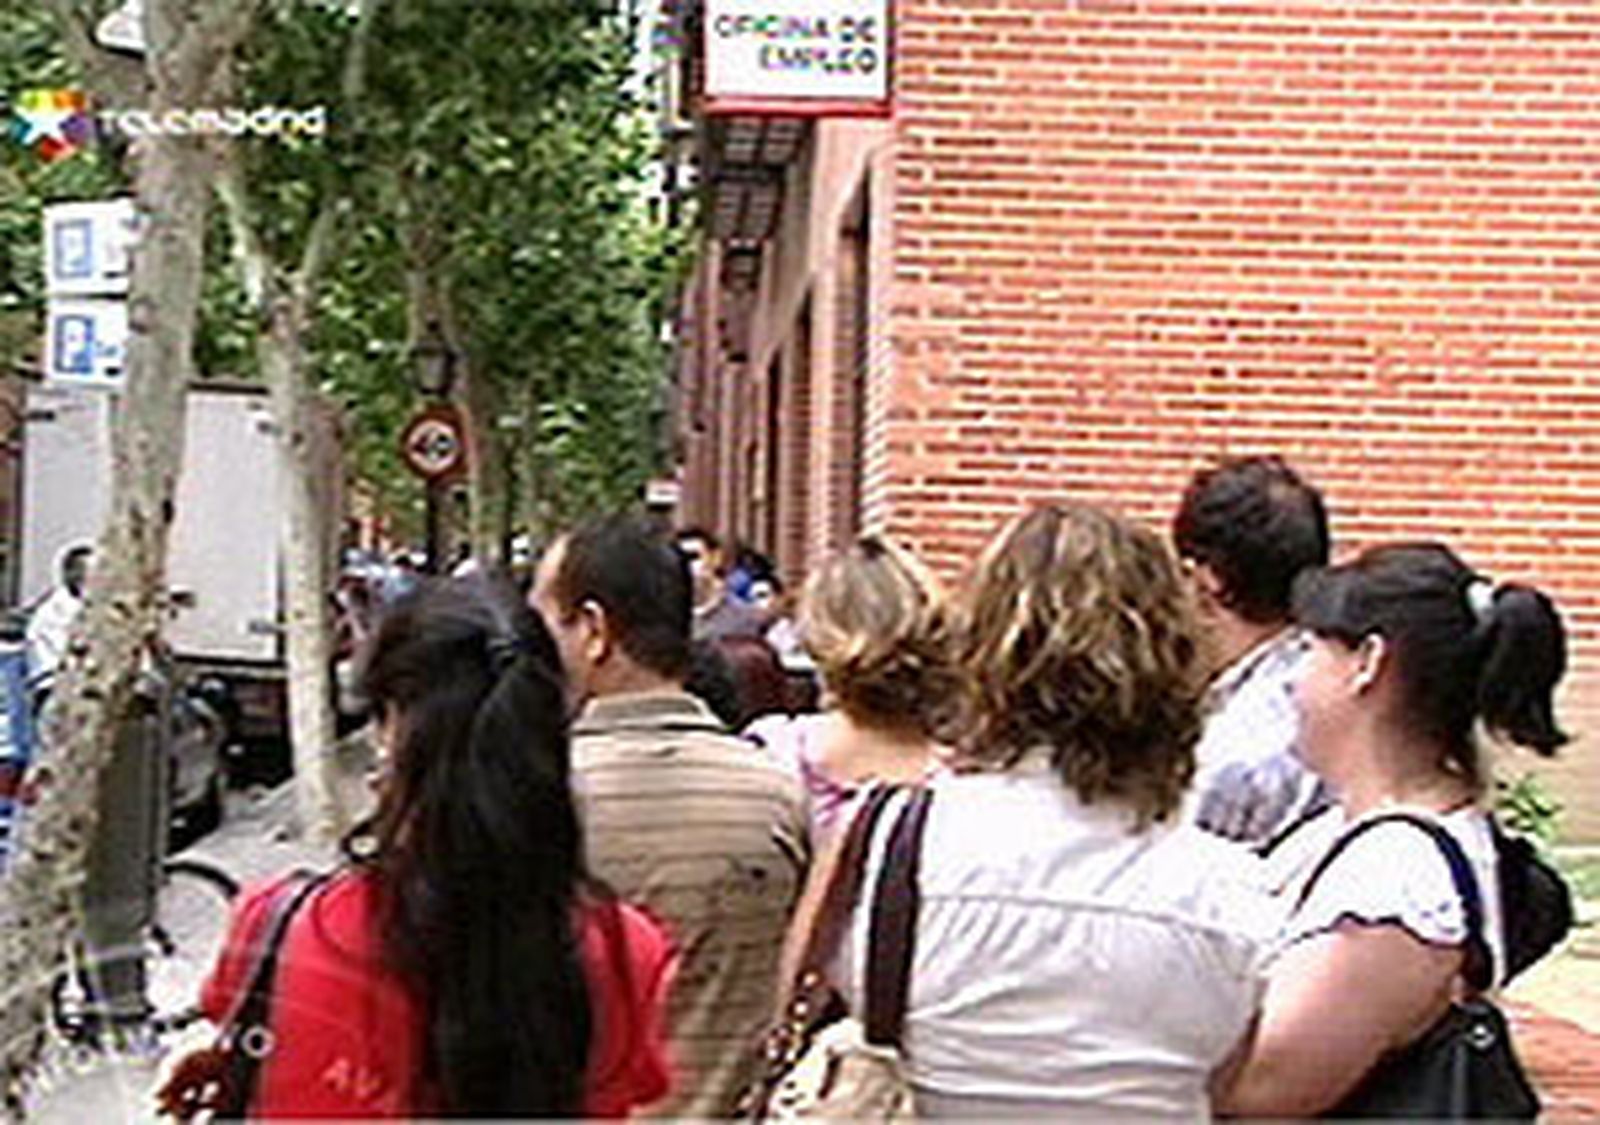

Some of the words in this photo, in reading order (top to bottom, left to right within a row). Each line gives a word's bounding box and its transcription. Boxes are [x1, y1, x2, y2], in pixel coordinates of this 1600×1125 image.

[714, 14, 830, 38] OFICINA
[839, 16, 876, 43] DE
[759, 45, 878, 75] EMPLEO
